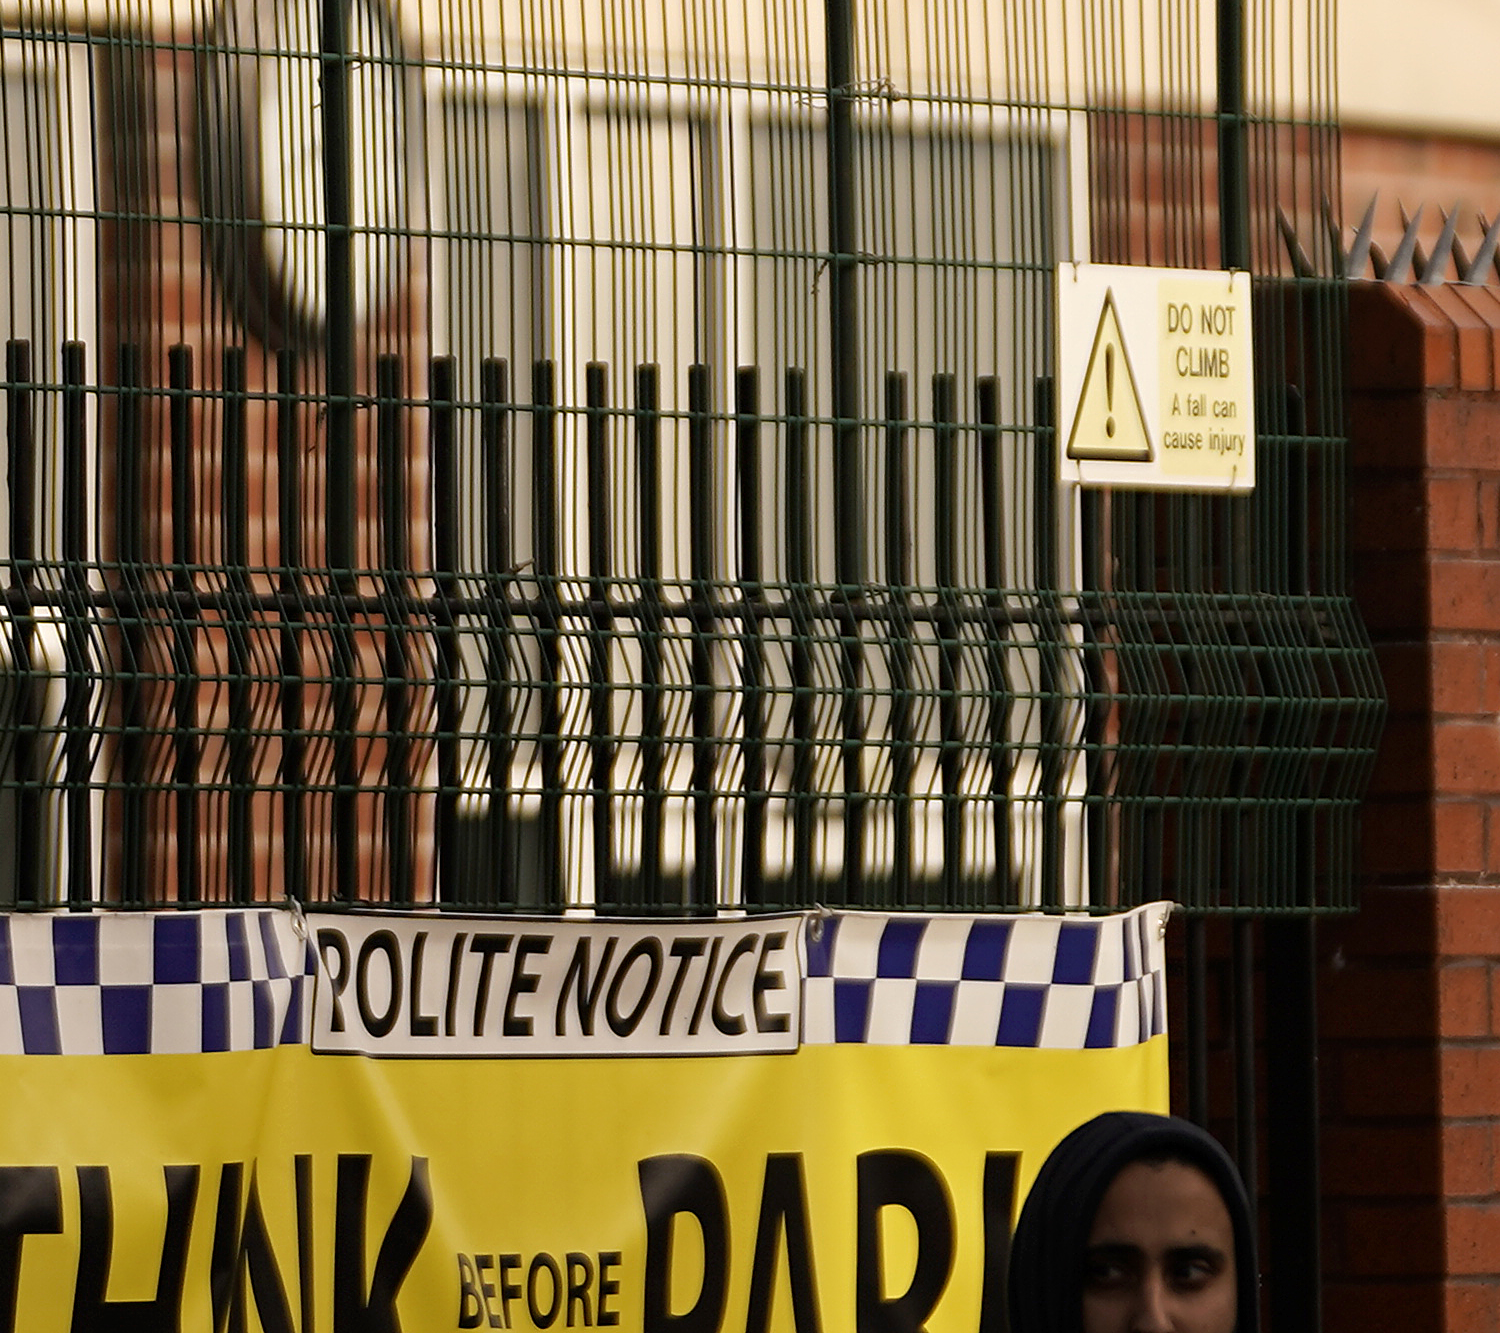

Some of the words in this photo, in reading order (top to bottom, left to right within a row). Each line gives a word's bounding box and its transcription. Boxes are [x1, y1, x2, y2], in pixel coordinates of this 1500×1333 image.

[1167, 302, 1193, 333] DO
[1201, 304, 1236, 336] NOT
[1175, 345, 1230, 379] CLIMB
[1171, 393, 1182, 417] A
[1186, 393, 1207, 418] fall
[1212, 400, 1237, 418] can
[1163, 430, 1203, 450] cause
[1208, 427, 1246, 456] injury
[316, 928, 554, 1039] POLITE
[555, 931, 792, 1039] NOTICE
[457, 1250, 622, 1330] BEFORE
[637, 1146, 1024, 1333] PAR
